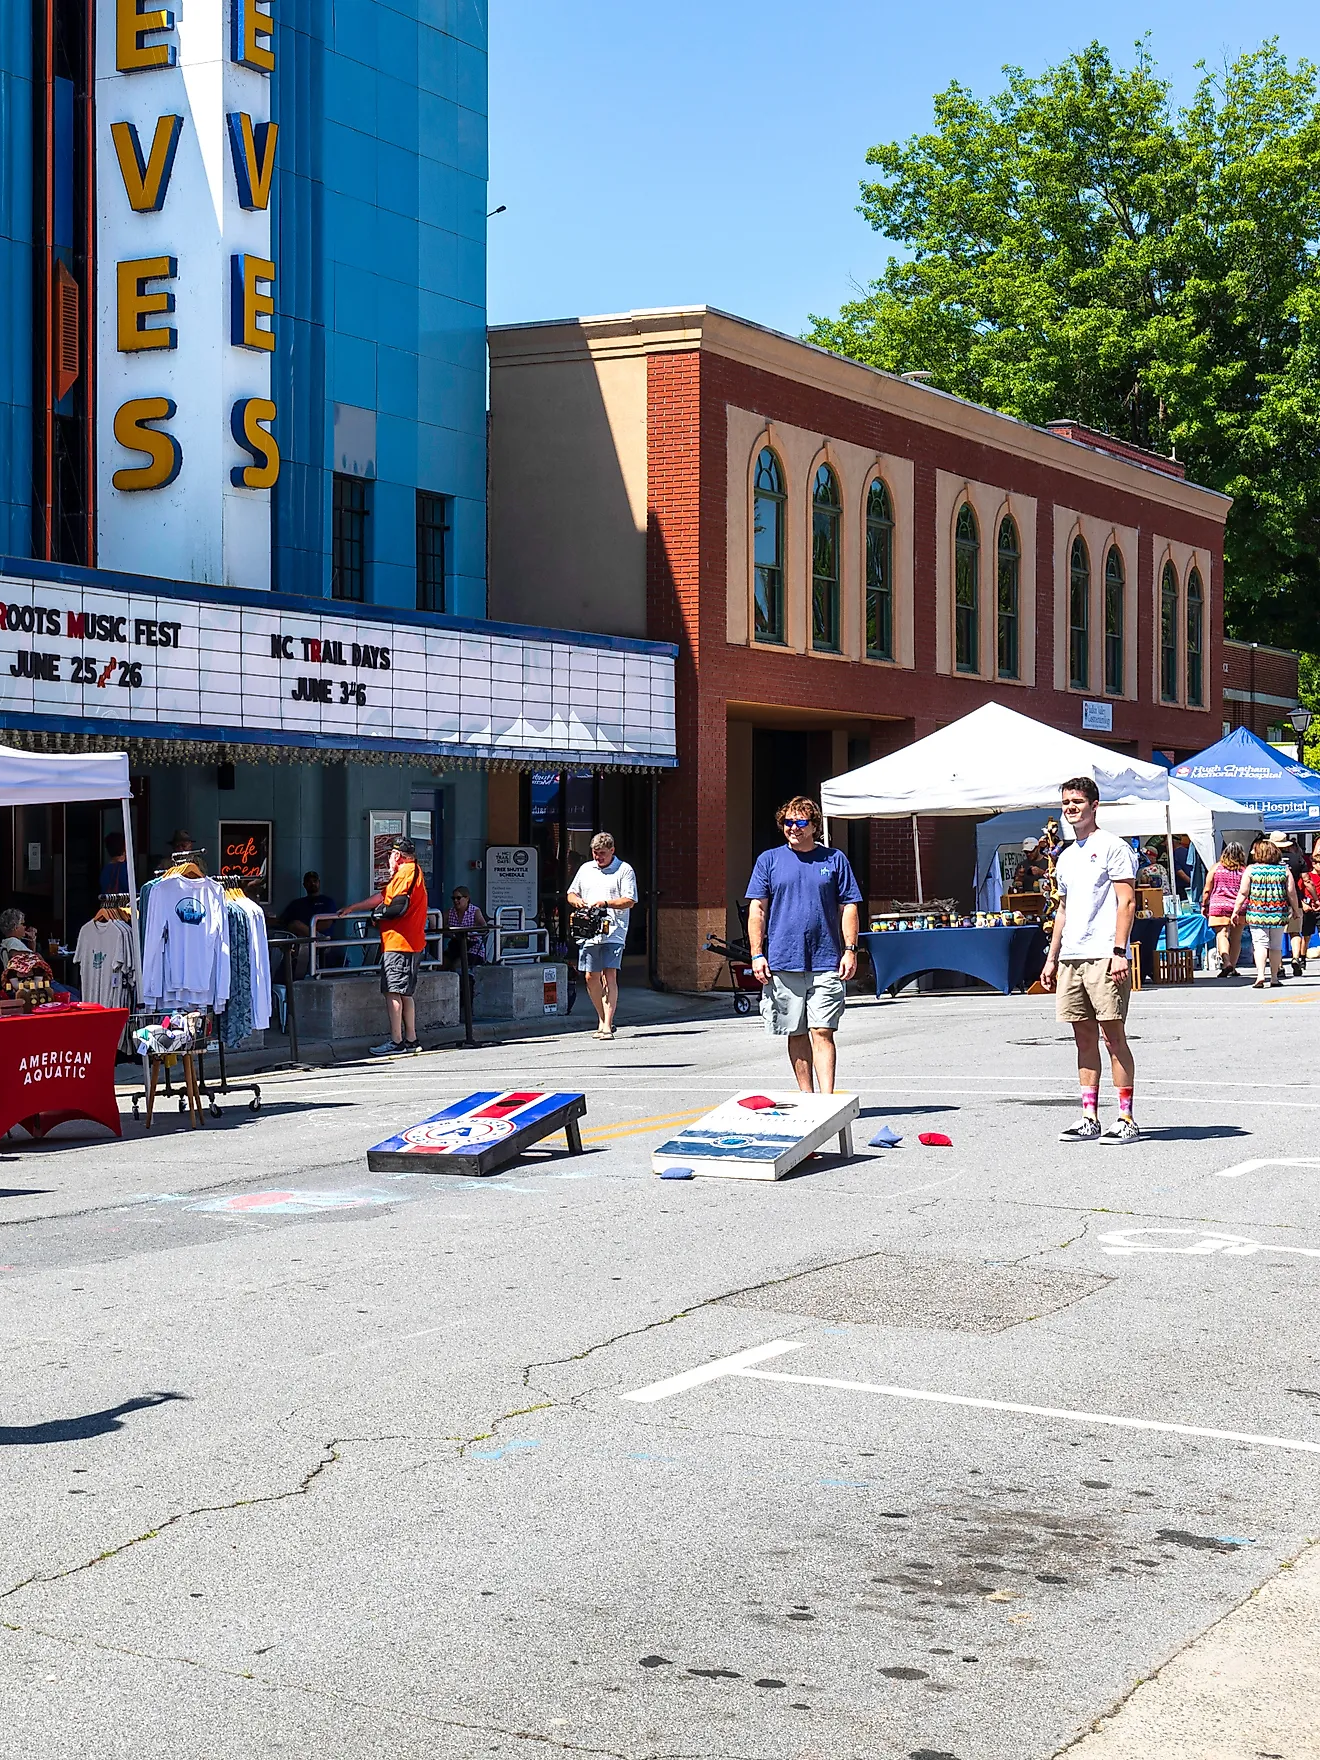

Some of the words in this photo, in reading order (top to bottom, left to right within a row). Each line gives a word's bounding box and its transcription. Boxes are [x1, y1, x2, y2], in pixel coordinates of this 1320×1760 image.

[67, 610, 127, 643] MUSIC
[134, 618, 182, 648] FEST
[270, 633, 294, 659] NC
[301, 637, 347, 666] TRAIL
[351, 642, 391, 670] DAYS
[10, 650, 61, 682] JUNE
[291, 677, 333, 704] JUNE
[1193, 764, 1221, 773] Hugh
[1223, 764, 1270, 773] Chatham
[1239, 771, 1282, 780] Hospital
[1262, 801, 1307, 816] Hospital
[226, 837, 258, 864] cafe
[19, 1050, 92, 1071] AMERICAN
[23, 1065, 86, 1086] AQUATIC
